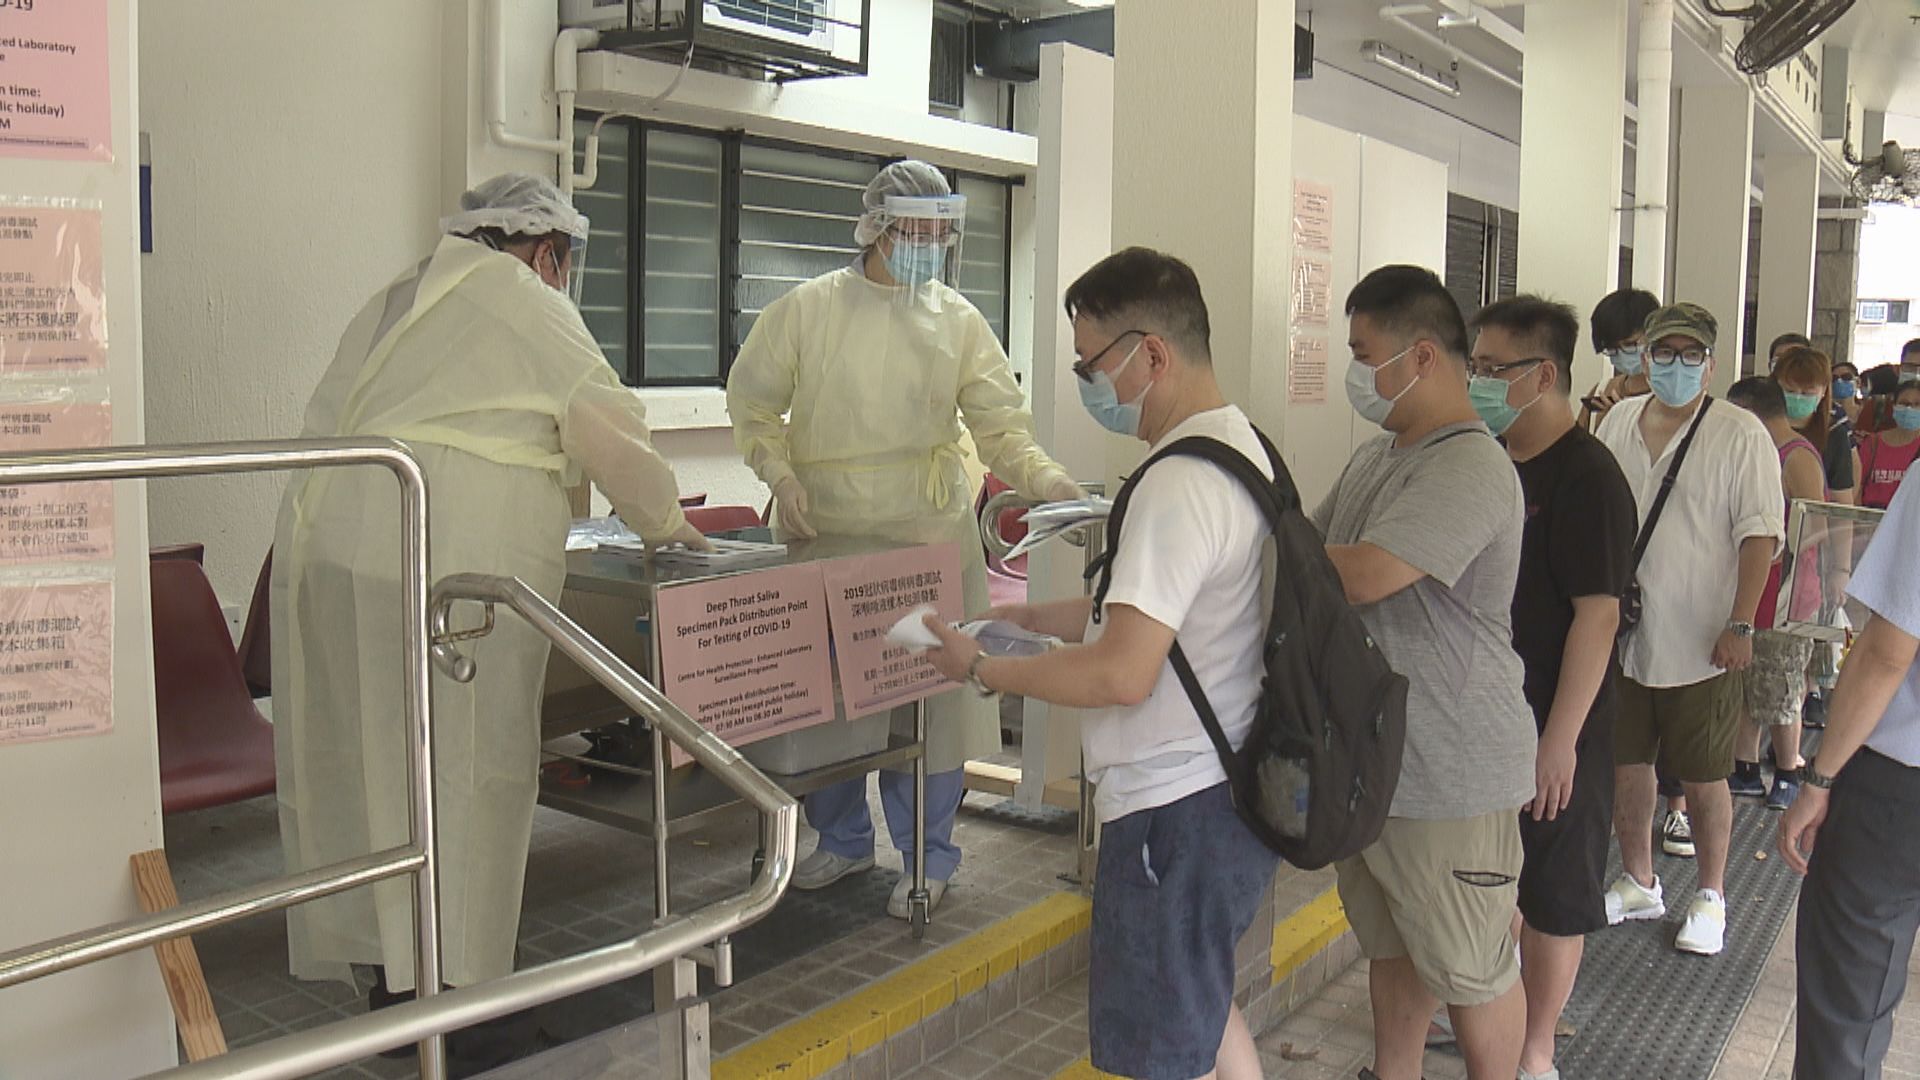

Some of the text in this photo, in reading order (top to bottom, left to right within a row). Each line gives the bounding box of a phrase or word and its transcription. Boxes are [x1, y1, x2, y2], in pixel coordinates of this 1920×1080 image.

[18, 38, 76, 55] Laboratory
[10, 85, 41, 97] time:
[16, 103, 65, 118] holiday)
[706, 590, 780, 614] Deep Throat Saliva
[0, 616, 81, 636] 病病毒測試
[677, 600, 808, 638] Specimen Pack Distribution Point
[698, 619, 791, 649] For Testing of COVID-19
[678, 672, 696, 684] Centre
[696, 669, 706, 678] for
[706, 664, 725, 677] Health
[725, 658, 754, 671] Protection
[757, 650, 783, 663] Enhanced
[784, 644, 812, 657] Laboratory
[714, 663, 779, 685] Surveillance Programme
[698, 680, 797, 713] Specimen pack distribution time:
[714, 711, 721, 721] to
[722, 706, 741, 720] Friday
[742, 700, 764, 714] (except
[765, 695, 783, 708] public
[784, 688, 809, 702] holiday)
[734, 717, 745, 728] AM
[746, 715, 752, 724] to
[772, 706, 783, 718] AM
